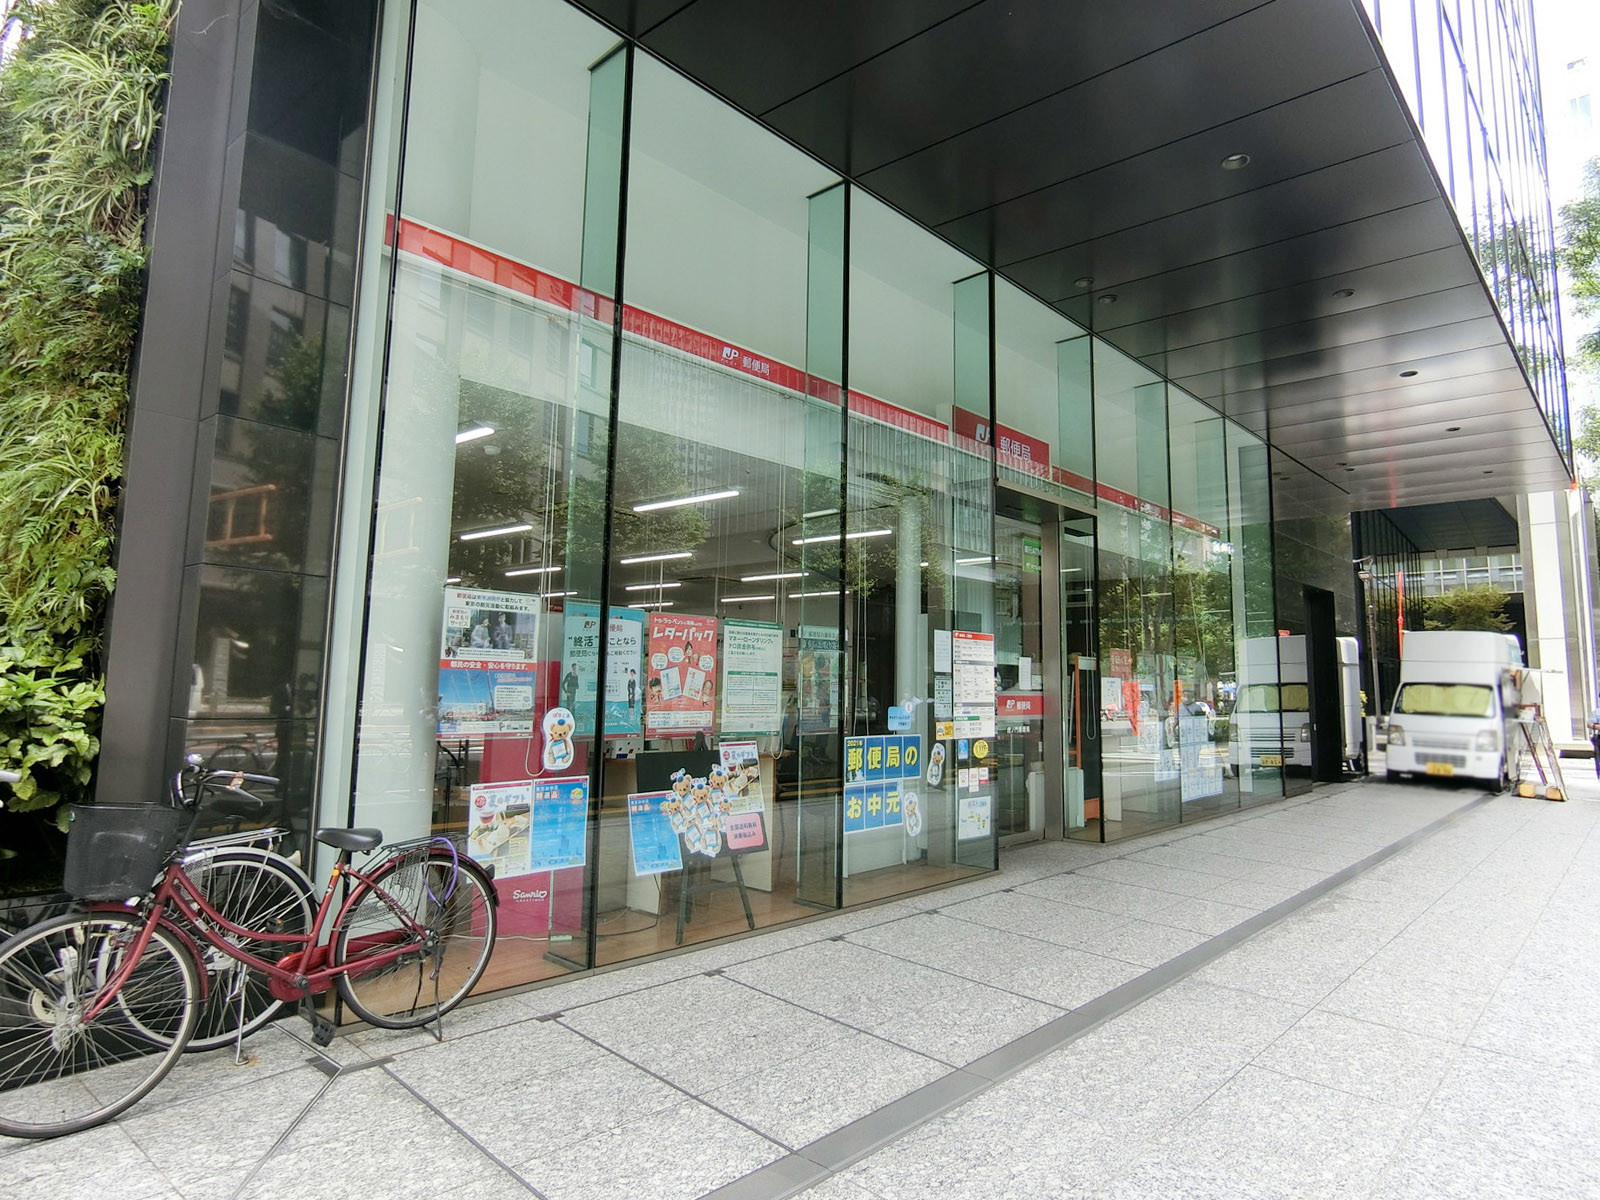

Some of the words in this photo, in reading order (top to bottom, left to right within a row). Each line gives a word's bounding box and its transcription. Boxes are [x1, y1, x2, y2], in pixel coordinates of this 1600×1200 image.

[742, 355, 770, 376] 郵便局
[1000, 436, 1031, 464] 郵便局
[653, 626, 714, 642] レターパック
[846, 746, 918, 771] 郵便局の
[846, 792, 900, 820] お中元
[512, 890, 548, 900] Sanrio
